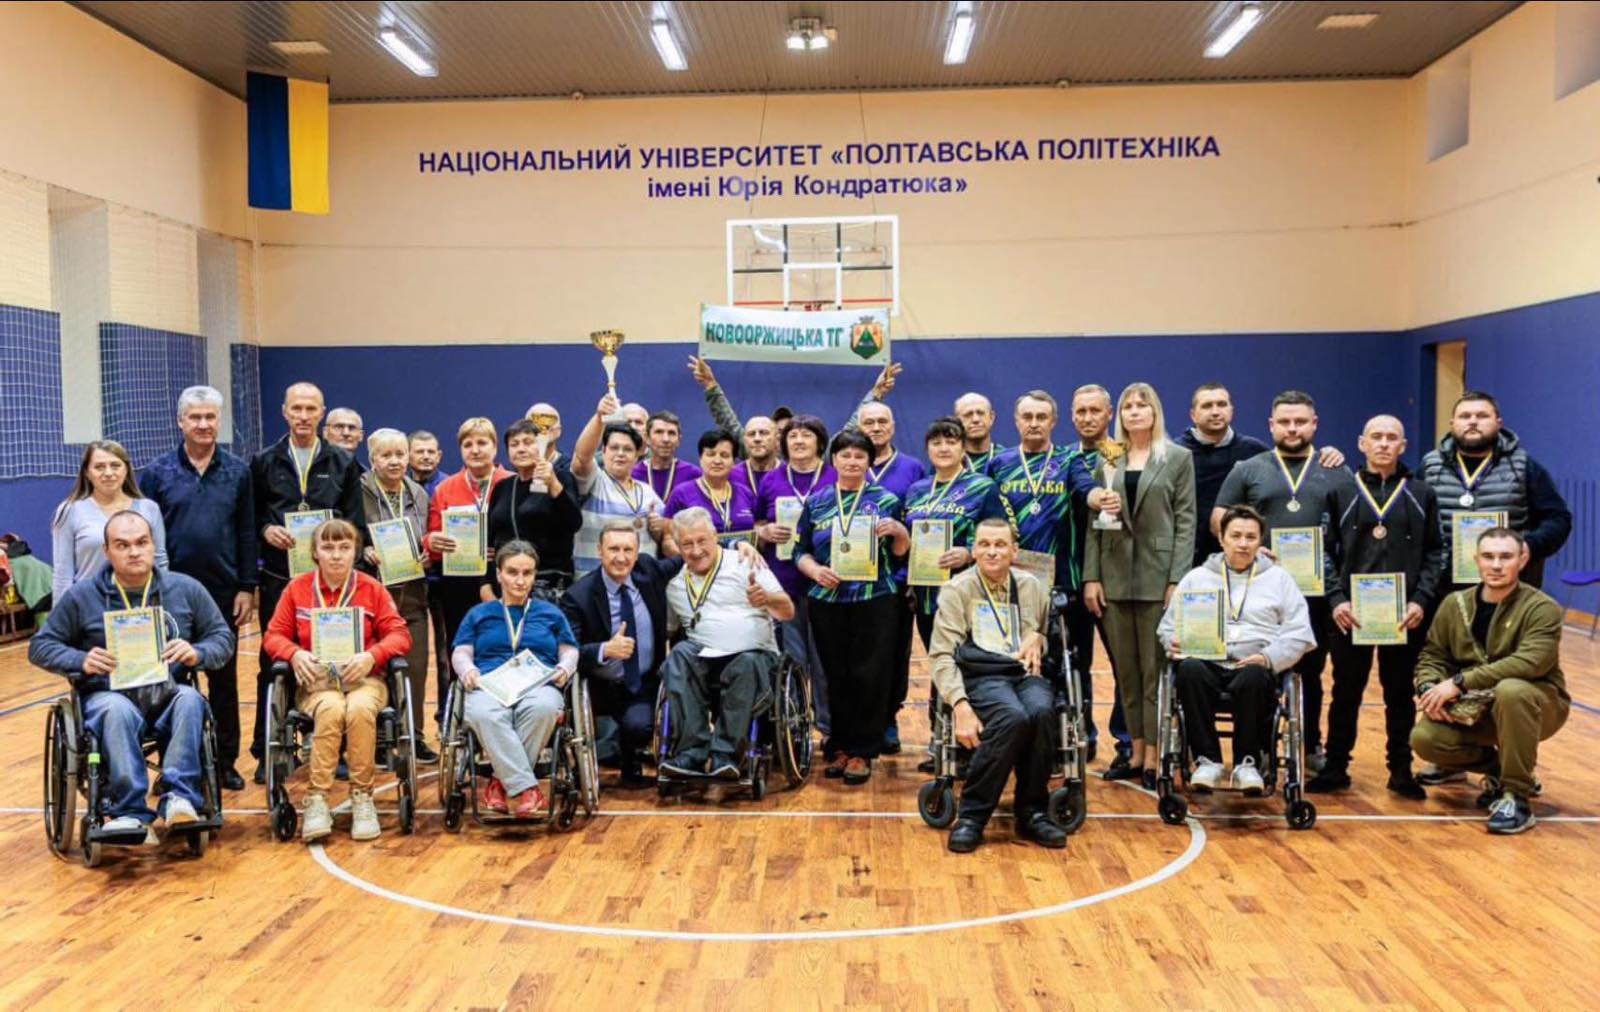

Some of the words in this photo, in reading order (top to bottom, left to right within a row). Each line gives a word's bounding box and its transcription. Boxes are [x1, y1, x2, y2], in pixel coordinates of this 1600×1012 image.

[420, 144, 631, 174] НАЦІОНАЛЬНИЙ
[640, 144, 822, 169] УНІВЕРСИТЕТ
[831, 140, 1029, 164] «ПОЛТАВСЬКА
[1037, 136, 1221, 161] ПОЛІТЕХНІКА
[647, 177, 711, 198] імені
[718, 175, 783, 201] Юрія
[794, 174, 967, 199] Кондратюка»
[705, 322, 824, 350] НОВООРЖИЦЬКА
[826, 327, 844, 347] ТГ
